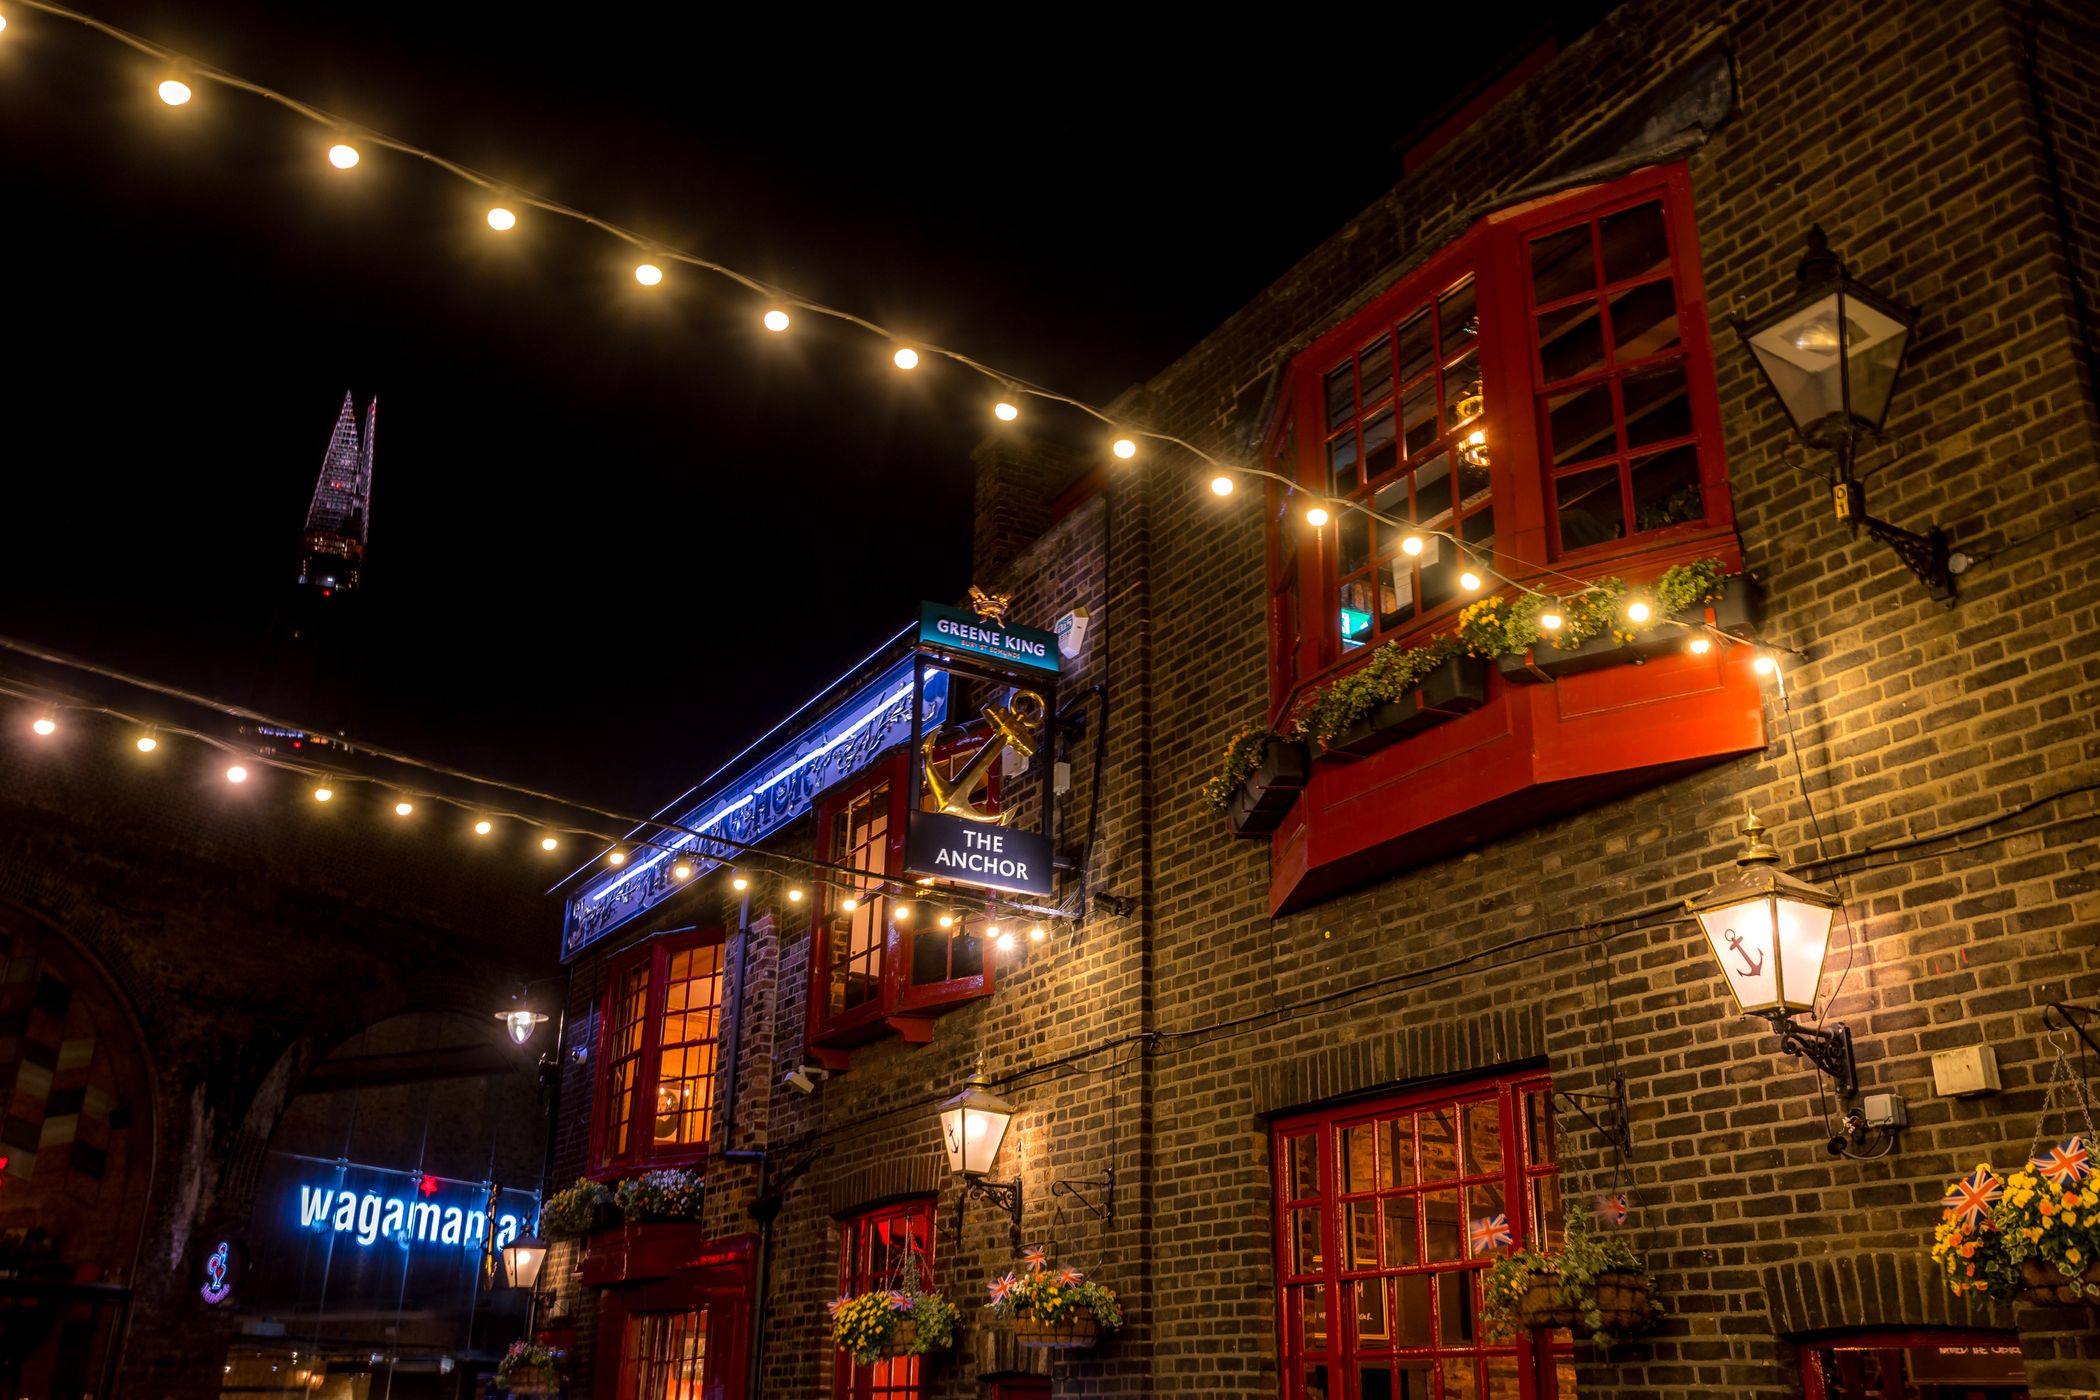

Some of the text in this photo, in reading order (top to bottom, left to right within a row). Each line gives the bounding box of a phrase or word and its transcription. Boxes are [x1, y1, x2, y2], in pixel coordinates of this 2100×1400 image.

[936, 618, 1000, 646] GREENE
[1005, 635, 1046, 657] KING
[963, 829, 1004, 853] THE
[935, 848, 1029, 880] ANCHOR
[301, 1183, 517, 1252] wagamama
